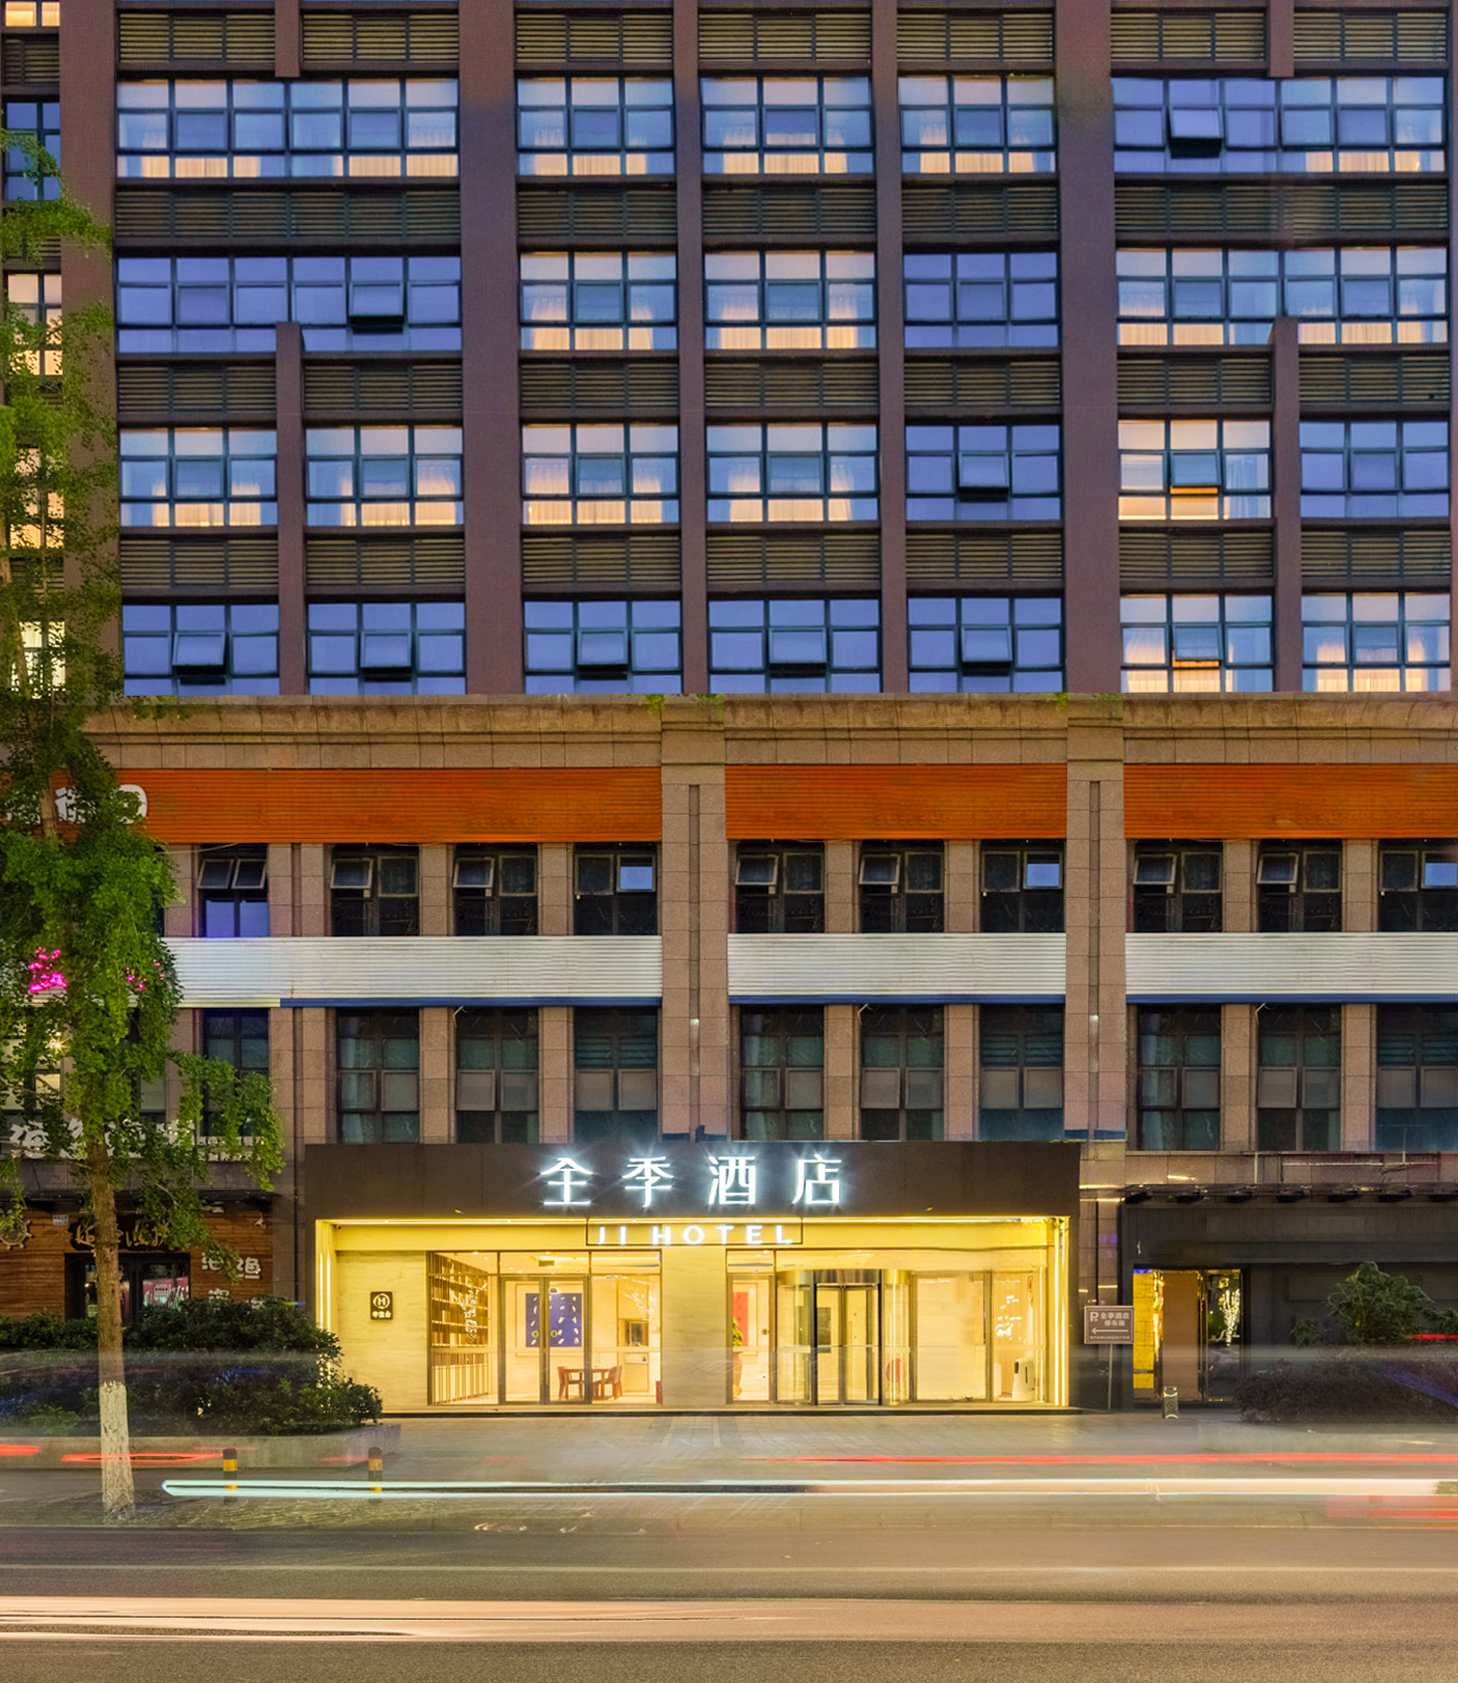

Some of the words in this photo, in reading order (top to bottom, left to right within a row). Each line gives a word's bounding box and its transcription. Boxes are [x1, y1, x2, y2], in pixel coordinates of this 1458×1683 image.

[540, 1154, 844, 1208] 全季酒店
[597, 1225, 627, 1245] JI
[651, 1225, 794, 1246] HOTEL
